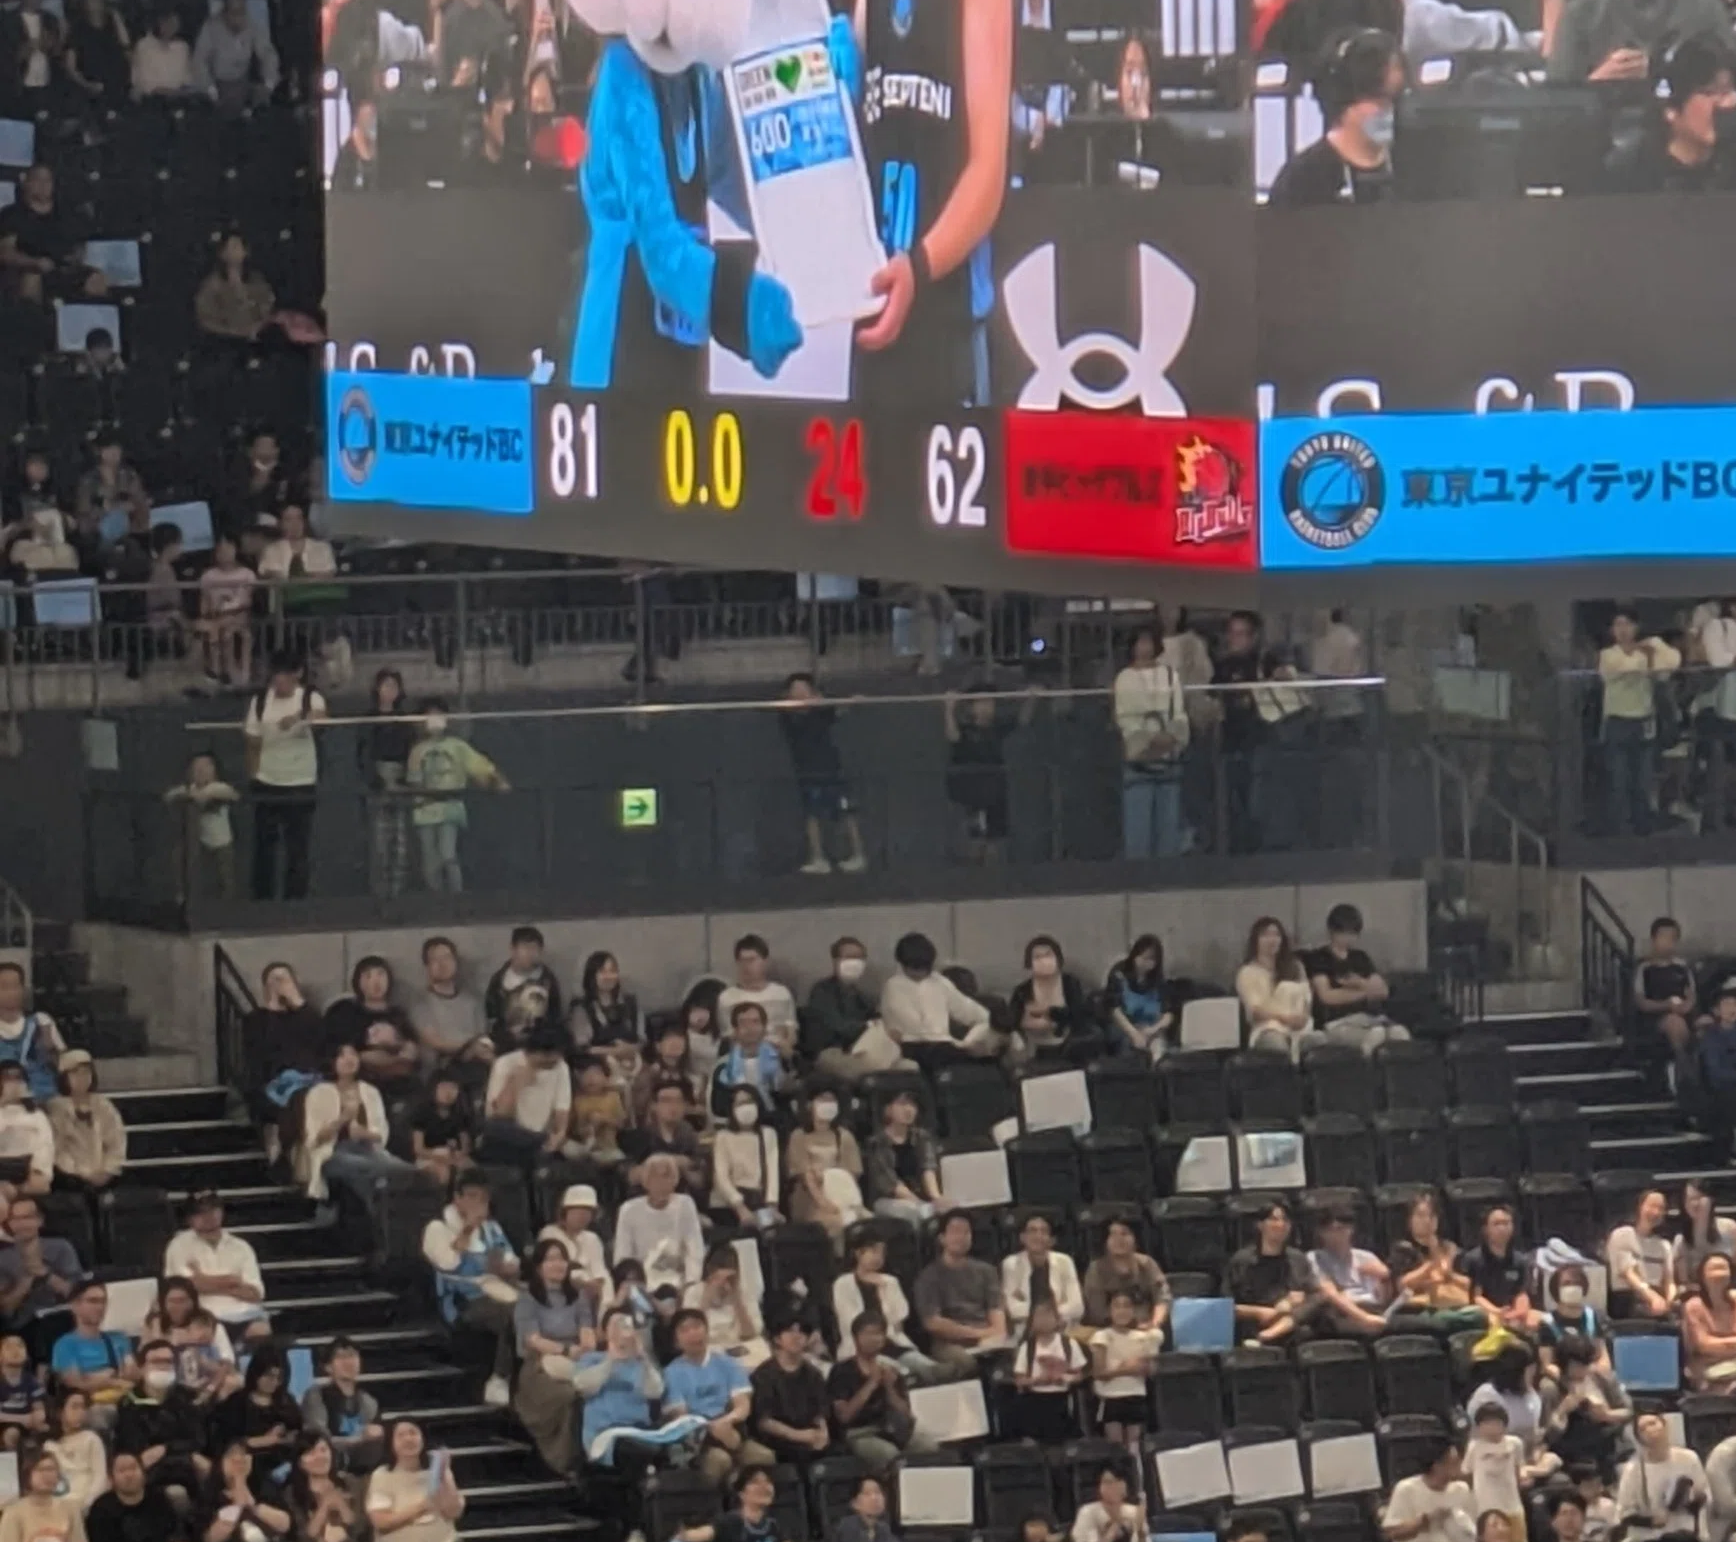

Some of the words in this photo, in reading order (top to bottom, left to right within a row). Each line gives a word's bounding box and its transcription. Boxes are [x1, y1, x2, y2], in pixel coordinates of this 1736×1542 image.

[549, 402, 598, 497] 81
[664, 409, 743, 509] 0.0
[806, 418, 866, 519] 24
[927, 424, 986, 527] 62
